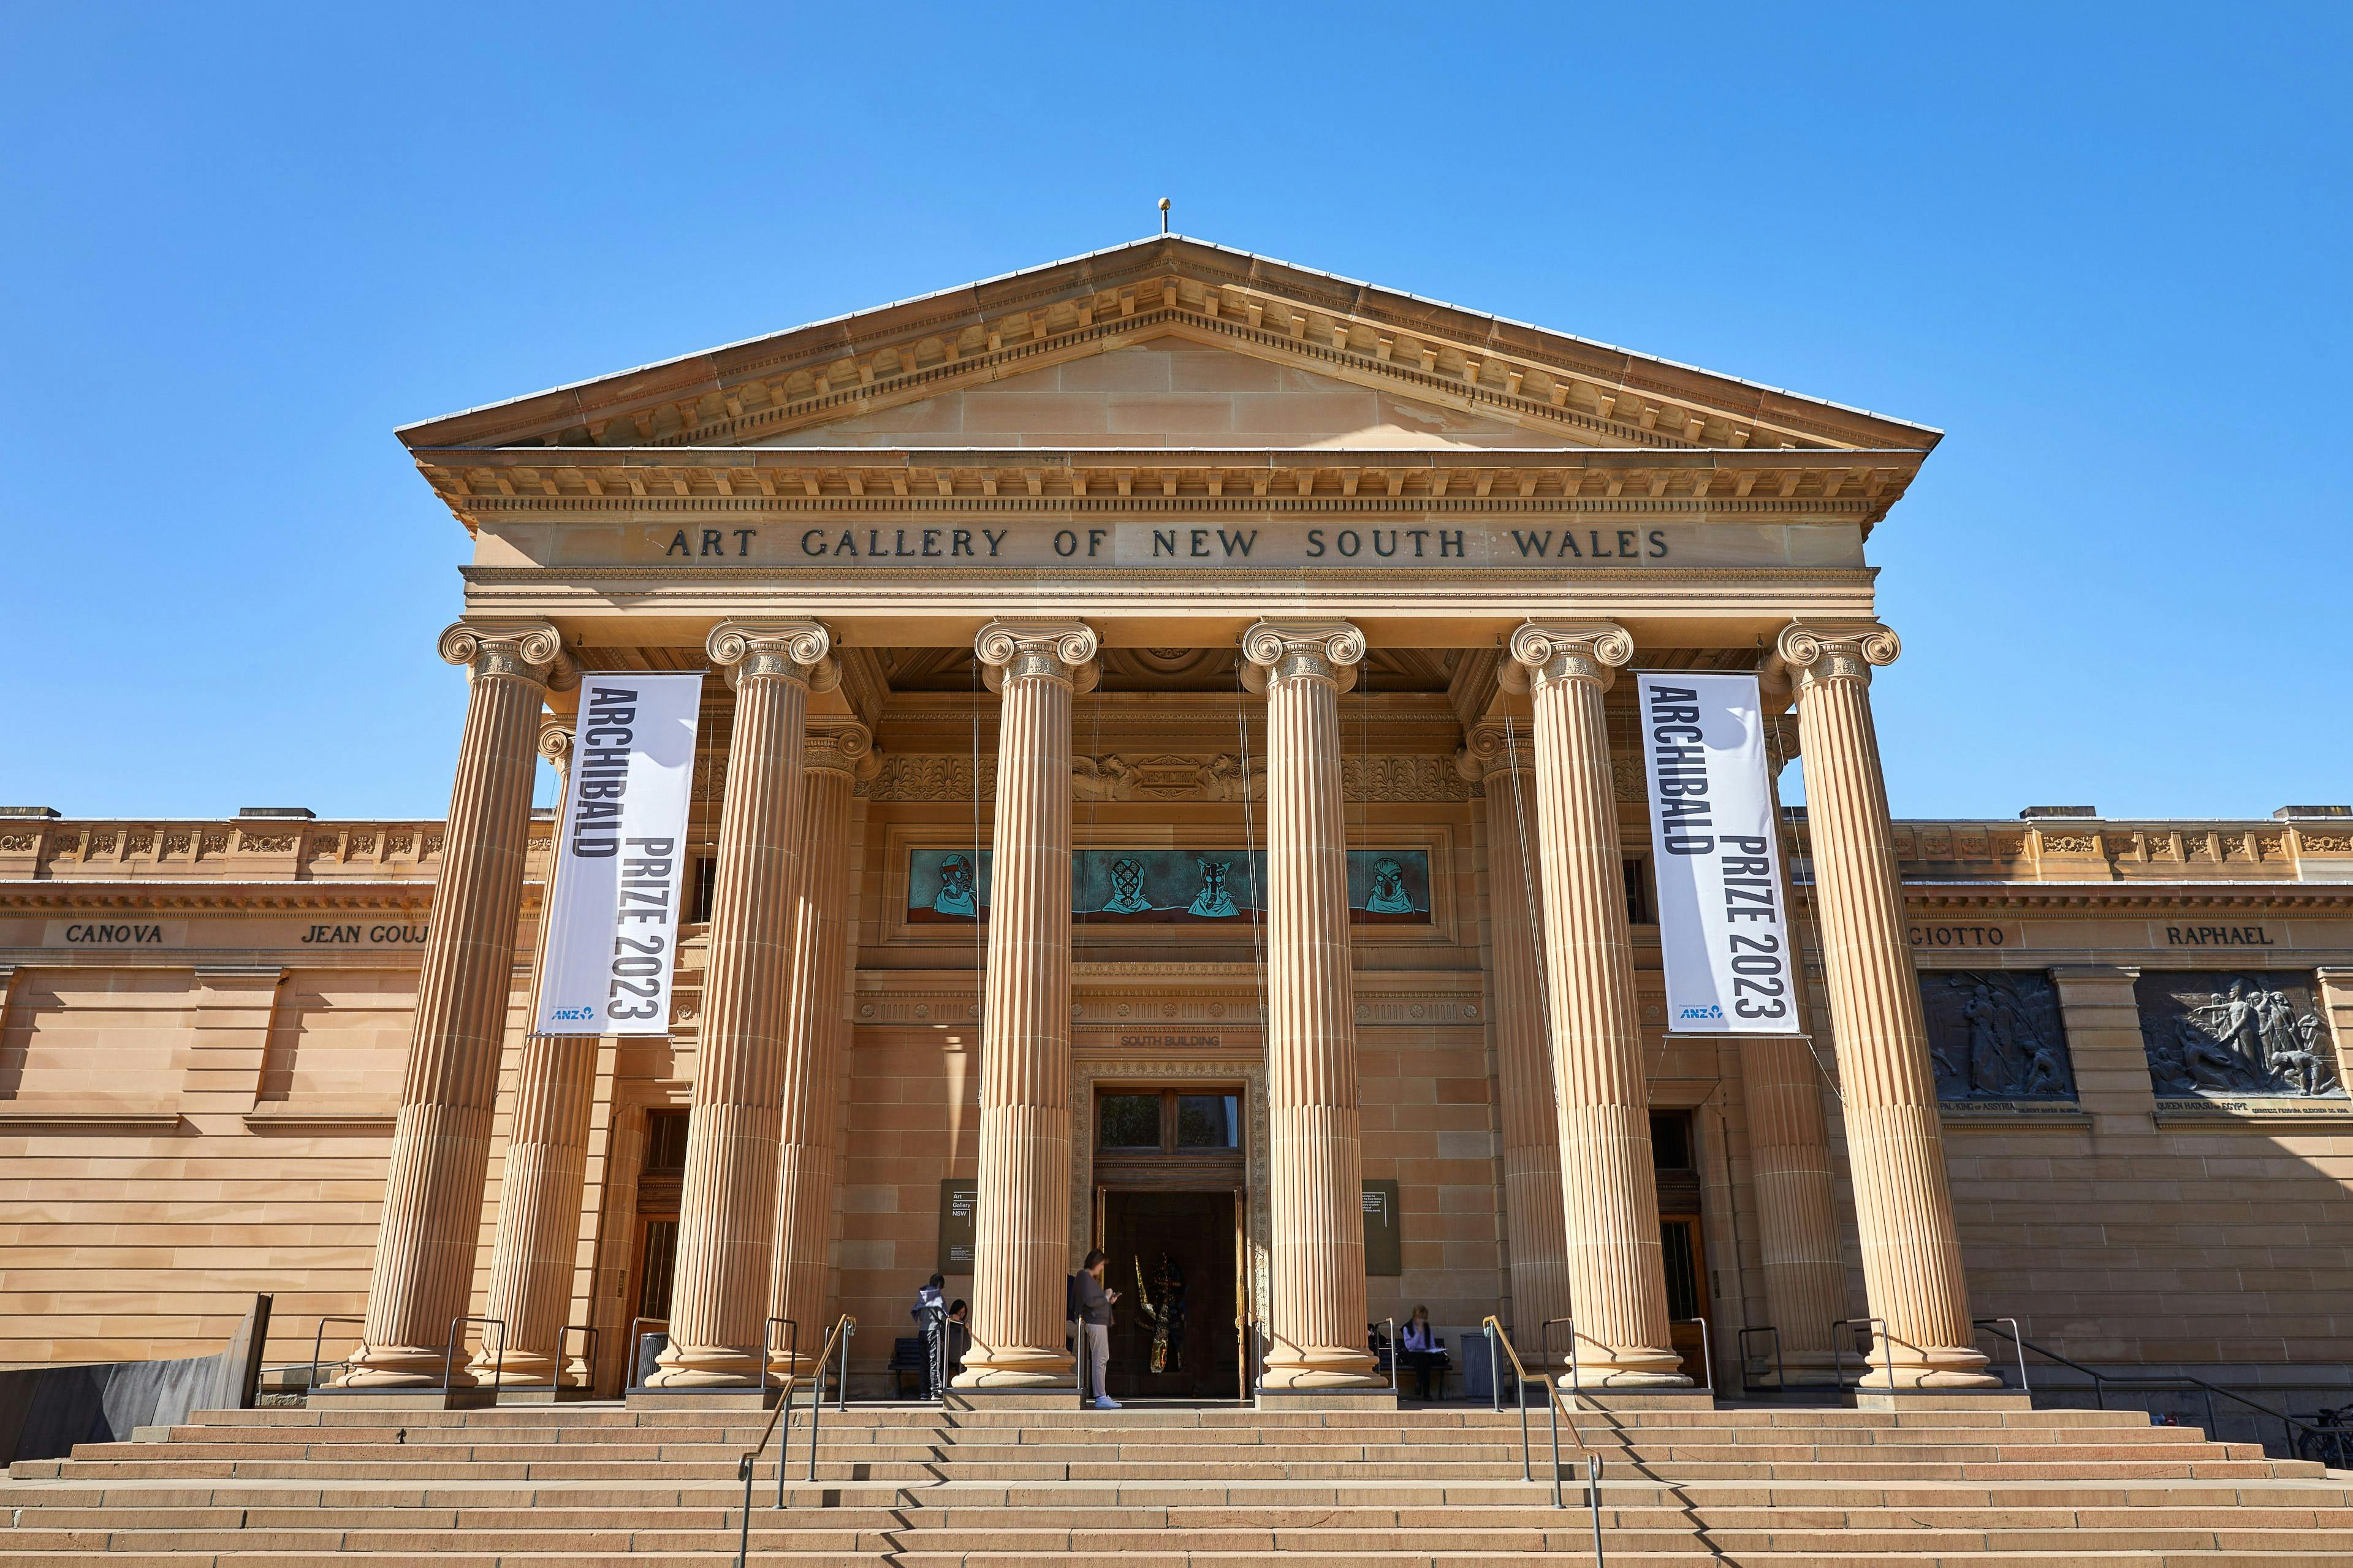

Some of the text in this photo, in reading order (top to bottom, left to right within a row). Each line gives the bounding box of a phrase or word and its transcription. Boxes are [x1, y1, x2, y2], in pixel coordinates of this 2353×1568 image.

[666, 529, 1668, 558] ART GALLERY OF NEW SOUTH WALES
[572, 687, 638, 858] ARCHIBALD
[1649, 685, 1714, 856] ARCHIBALD
[66, 924, 162, 943] CANOVA
[302, 925, 362, 943] JEAN
[607, 837, 675, 1021] PRIZE 2023
[1719, 835, 1786, 1019] PRIZE 2023
[1909, 927, 2004, 945] GIOTTO
[2166, 927, 2274, 945] RAPHAEL
[552, 1010, 580, 1020] ANZ
[1680, 1009, 1708, 1019] ANZ
[1121, 1036, 1220, 1046] SOUTH BUILDING
